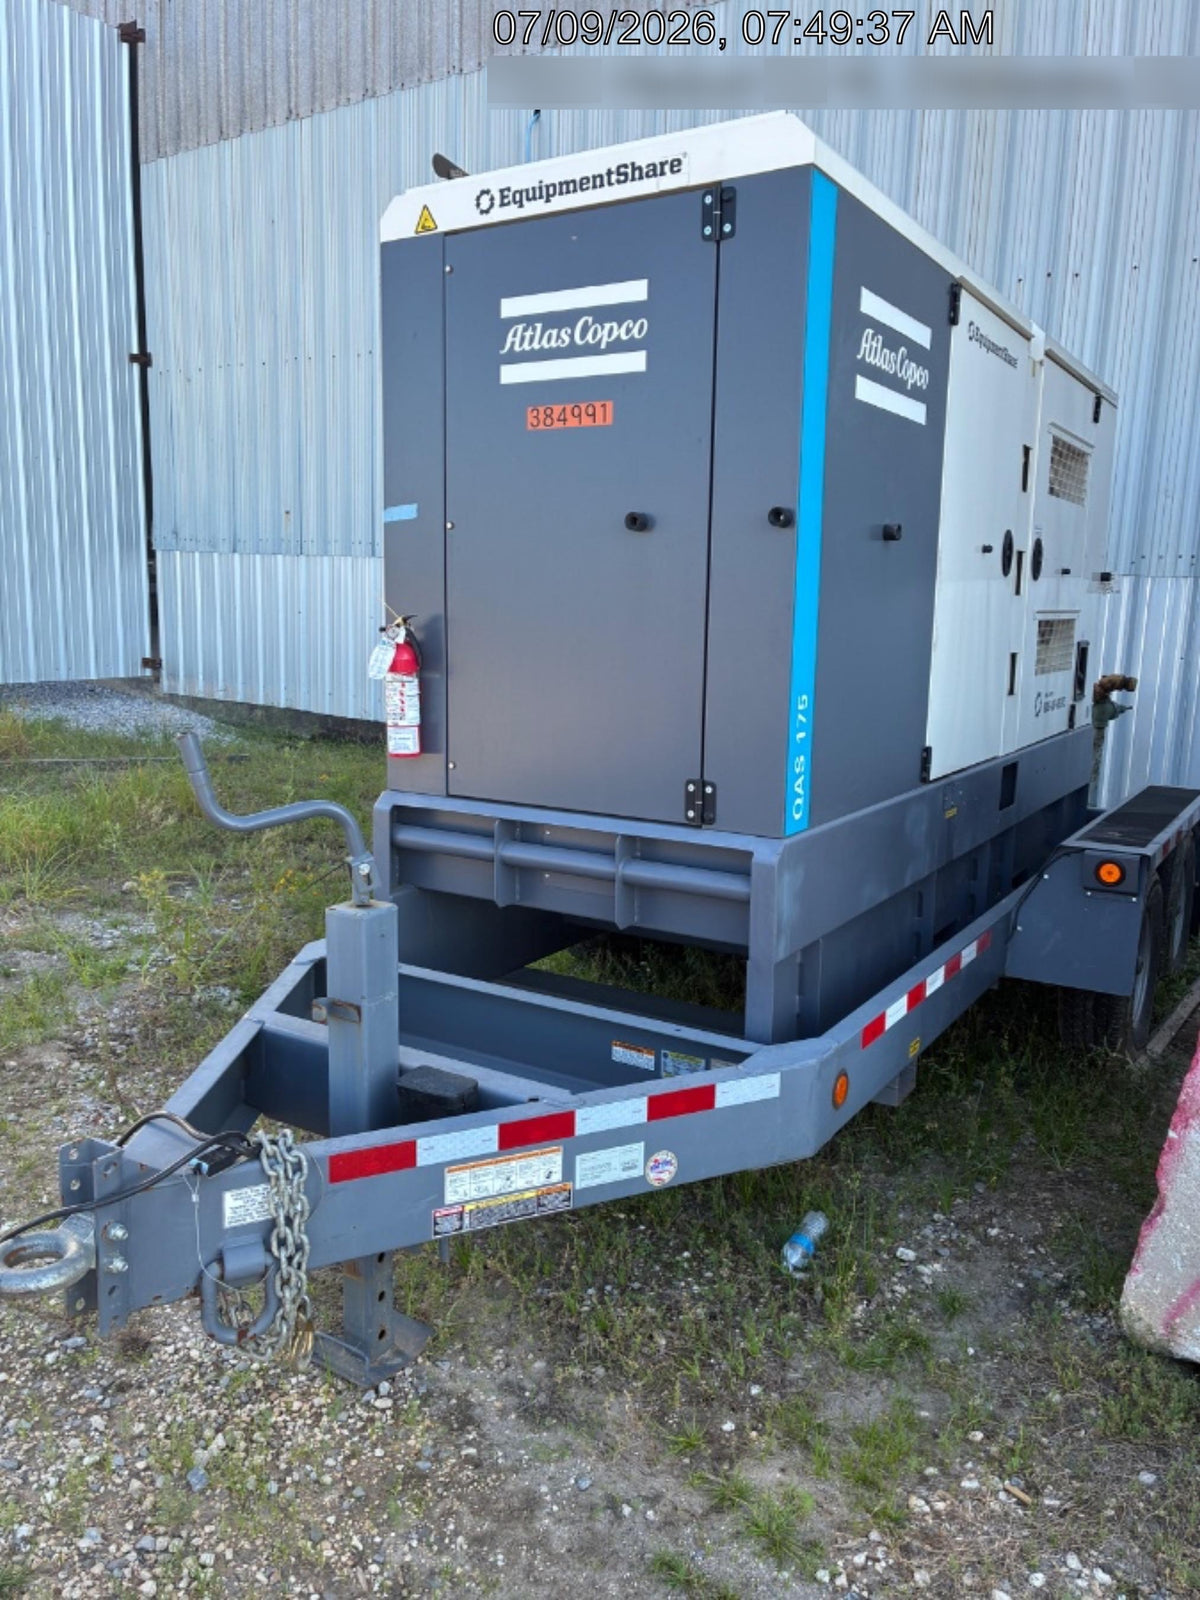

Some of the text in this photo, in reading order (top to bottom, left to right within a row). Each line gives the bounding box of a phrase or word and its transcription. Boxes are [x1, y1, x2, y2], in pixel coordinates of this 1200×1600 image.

[498, 156, 683, 209] EquipmentShare
[499, 315, 648, 354] Atlas Copco
[856, 328, 929, 390] Atlas Copco
[528, 403, 610, 428] 384991
[792, 694, 808, 821] QAS 175
